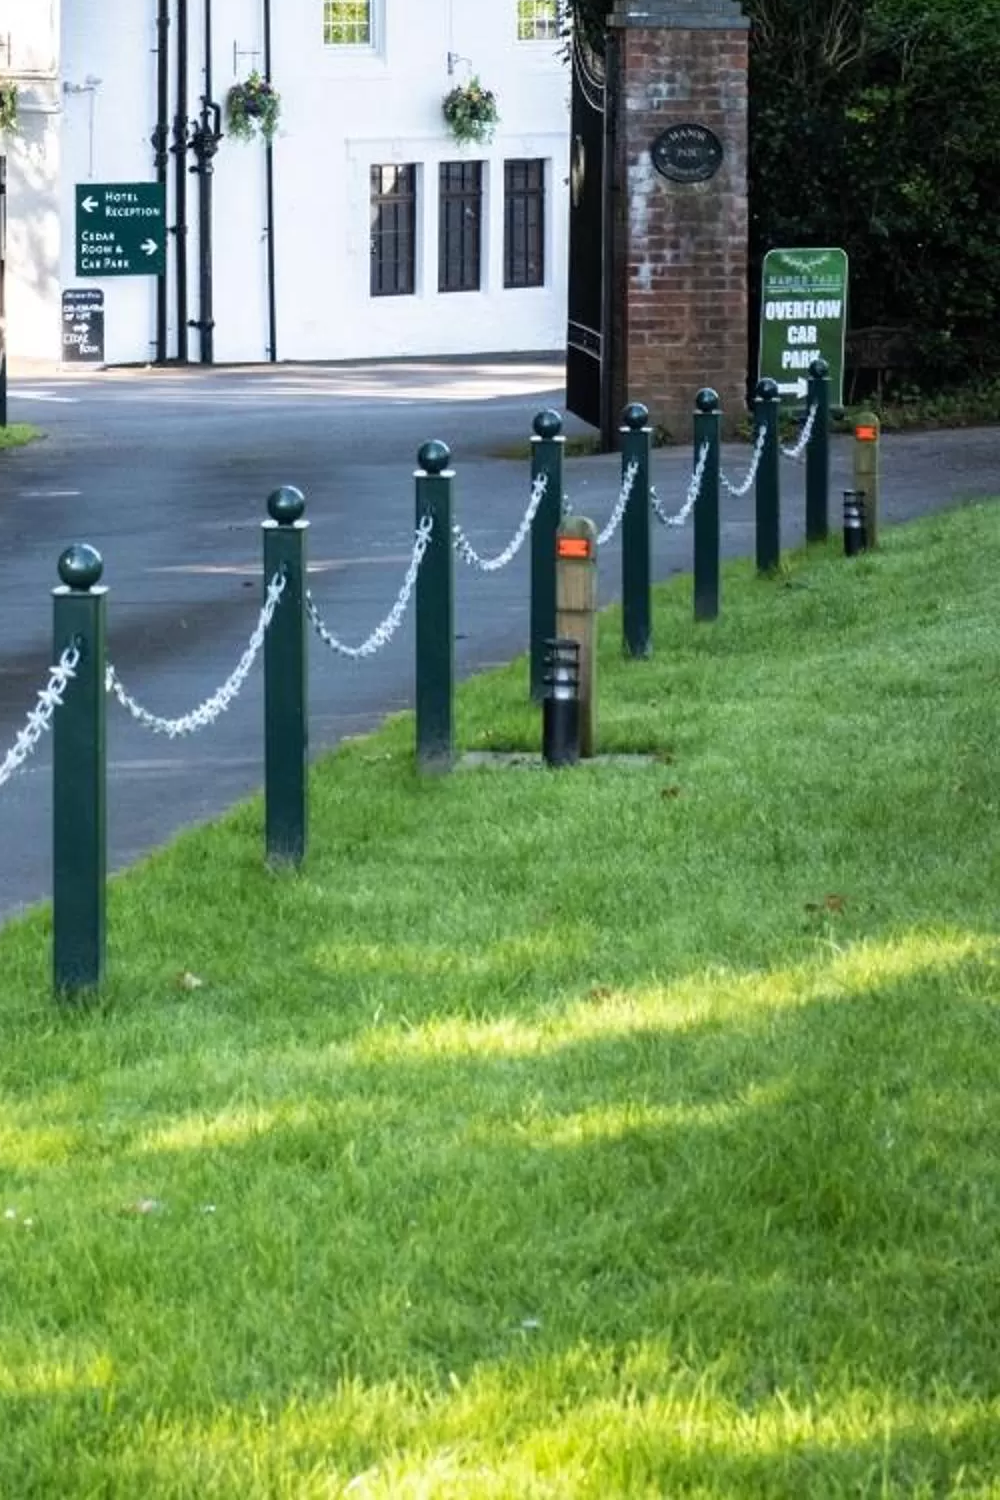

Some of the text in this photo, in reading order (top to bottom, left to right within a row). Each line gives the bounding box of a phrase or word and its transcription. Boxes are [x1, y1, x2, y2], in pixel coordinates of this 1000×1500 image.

[105, 192, 138, 202] HOTEL
[105, 206, 160, 217] RECEPTION
[81, 231, 115, 241] CEDAR
[81, 244, 124, 254] ROOM &
[81, 258, 129, 269] CAR PARK
[765, 300, 842, 320] OVERFLOW
[787, 325, 817, 344] CAR
[781, 350, 821, 369] PARK
